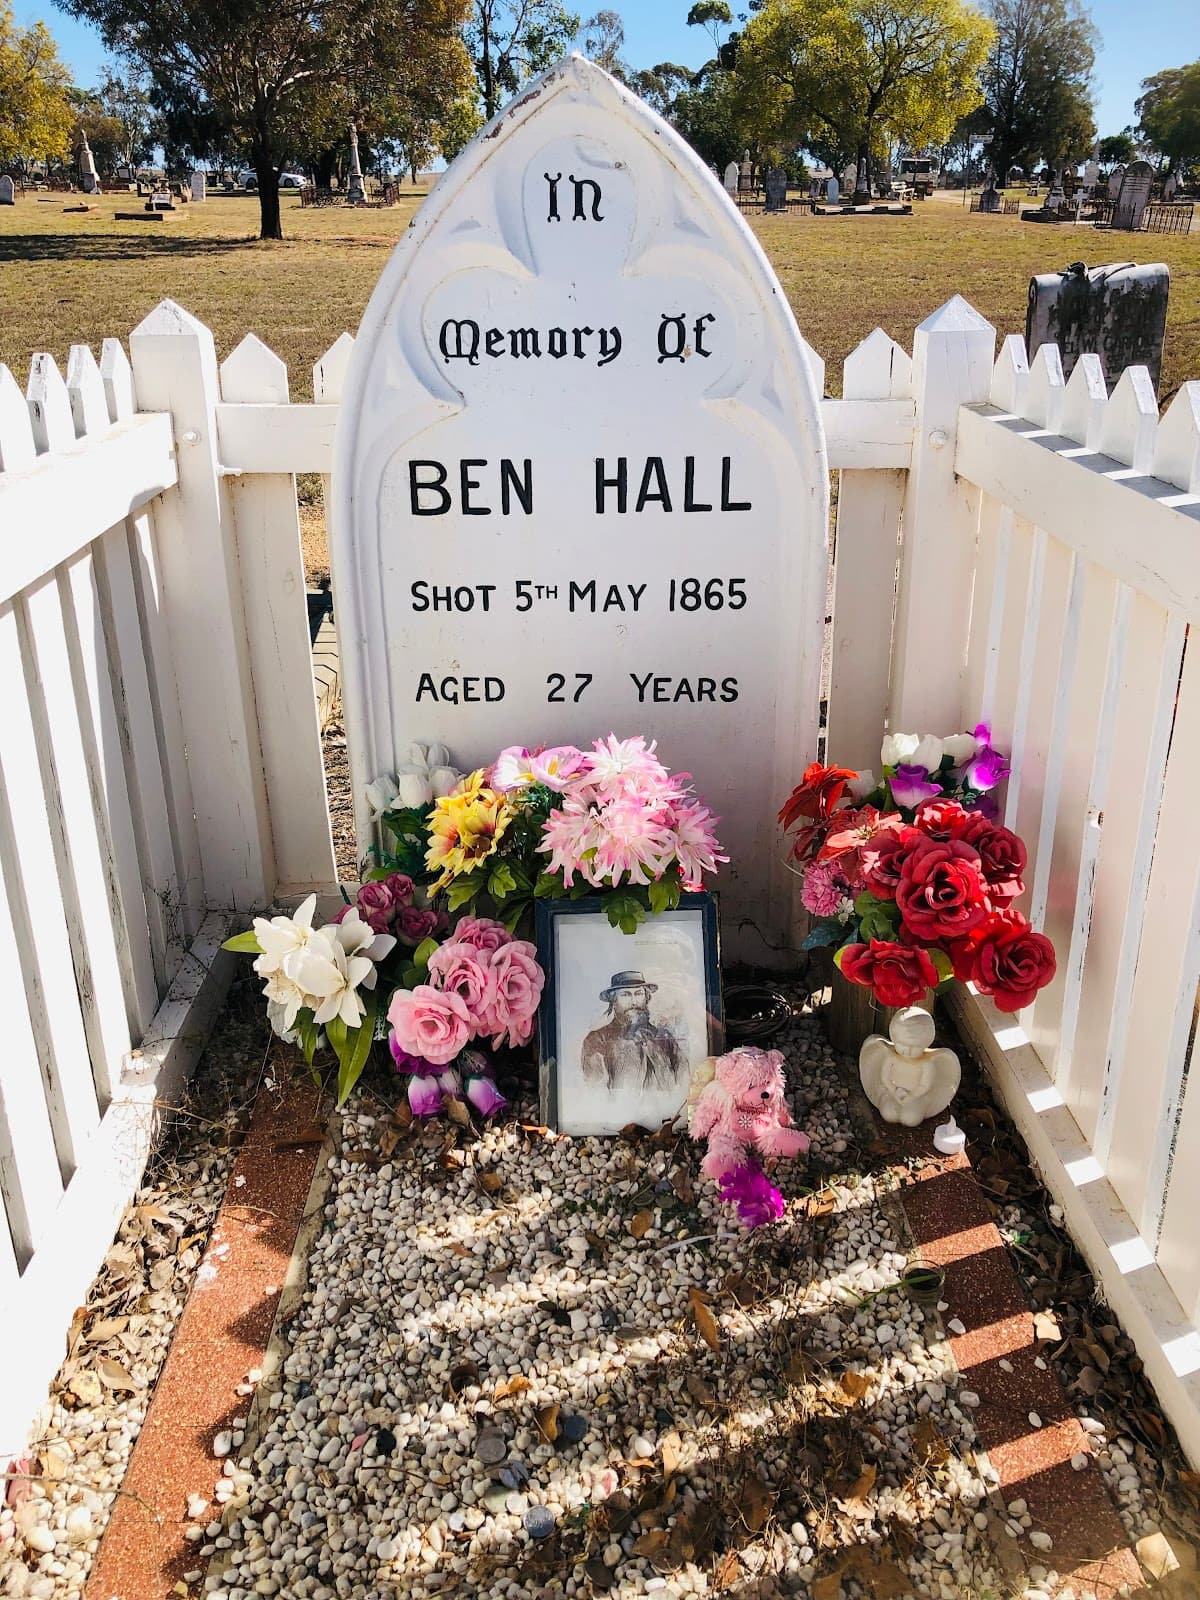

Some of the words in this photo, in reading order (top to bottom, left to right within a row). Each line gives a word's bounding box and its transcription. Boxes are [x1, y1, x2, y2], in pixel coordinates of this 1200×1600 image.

[438, 318, 622, 367] Memory
[657, 312, 716, 364] Of
[408, 458, 533, 516] BEN
[595, 456, 752, 514] HALL
[411, 580, 497, 612] SHOT
[515, 580, 558, 612] 5TH
[569, 579, 648, 613] MAY
[669, 577, 747, 612] 1865
[415, 672, 506, 705] AGED
[546, 672, 593, 703] 27
[629, 672, 739, 703] YEARS
